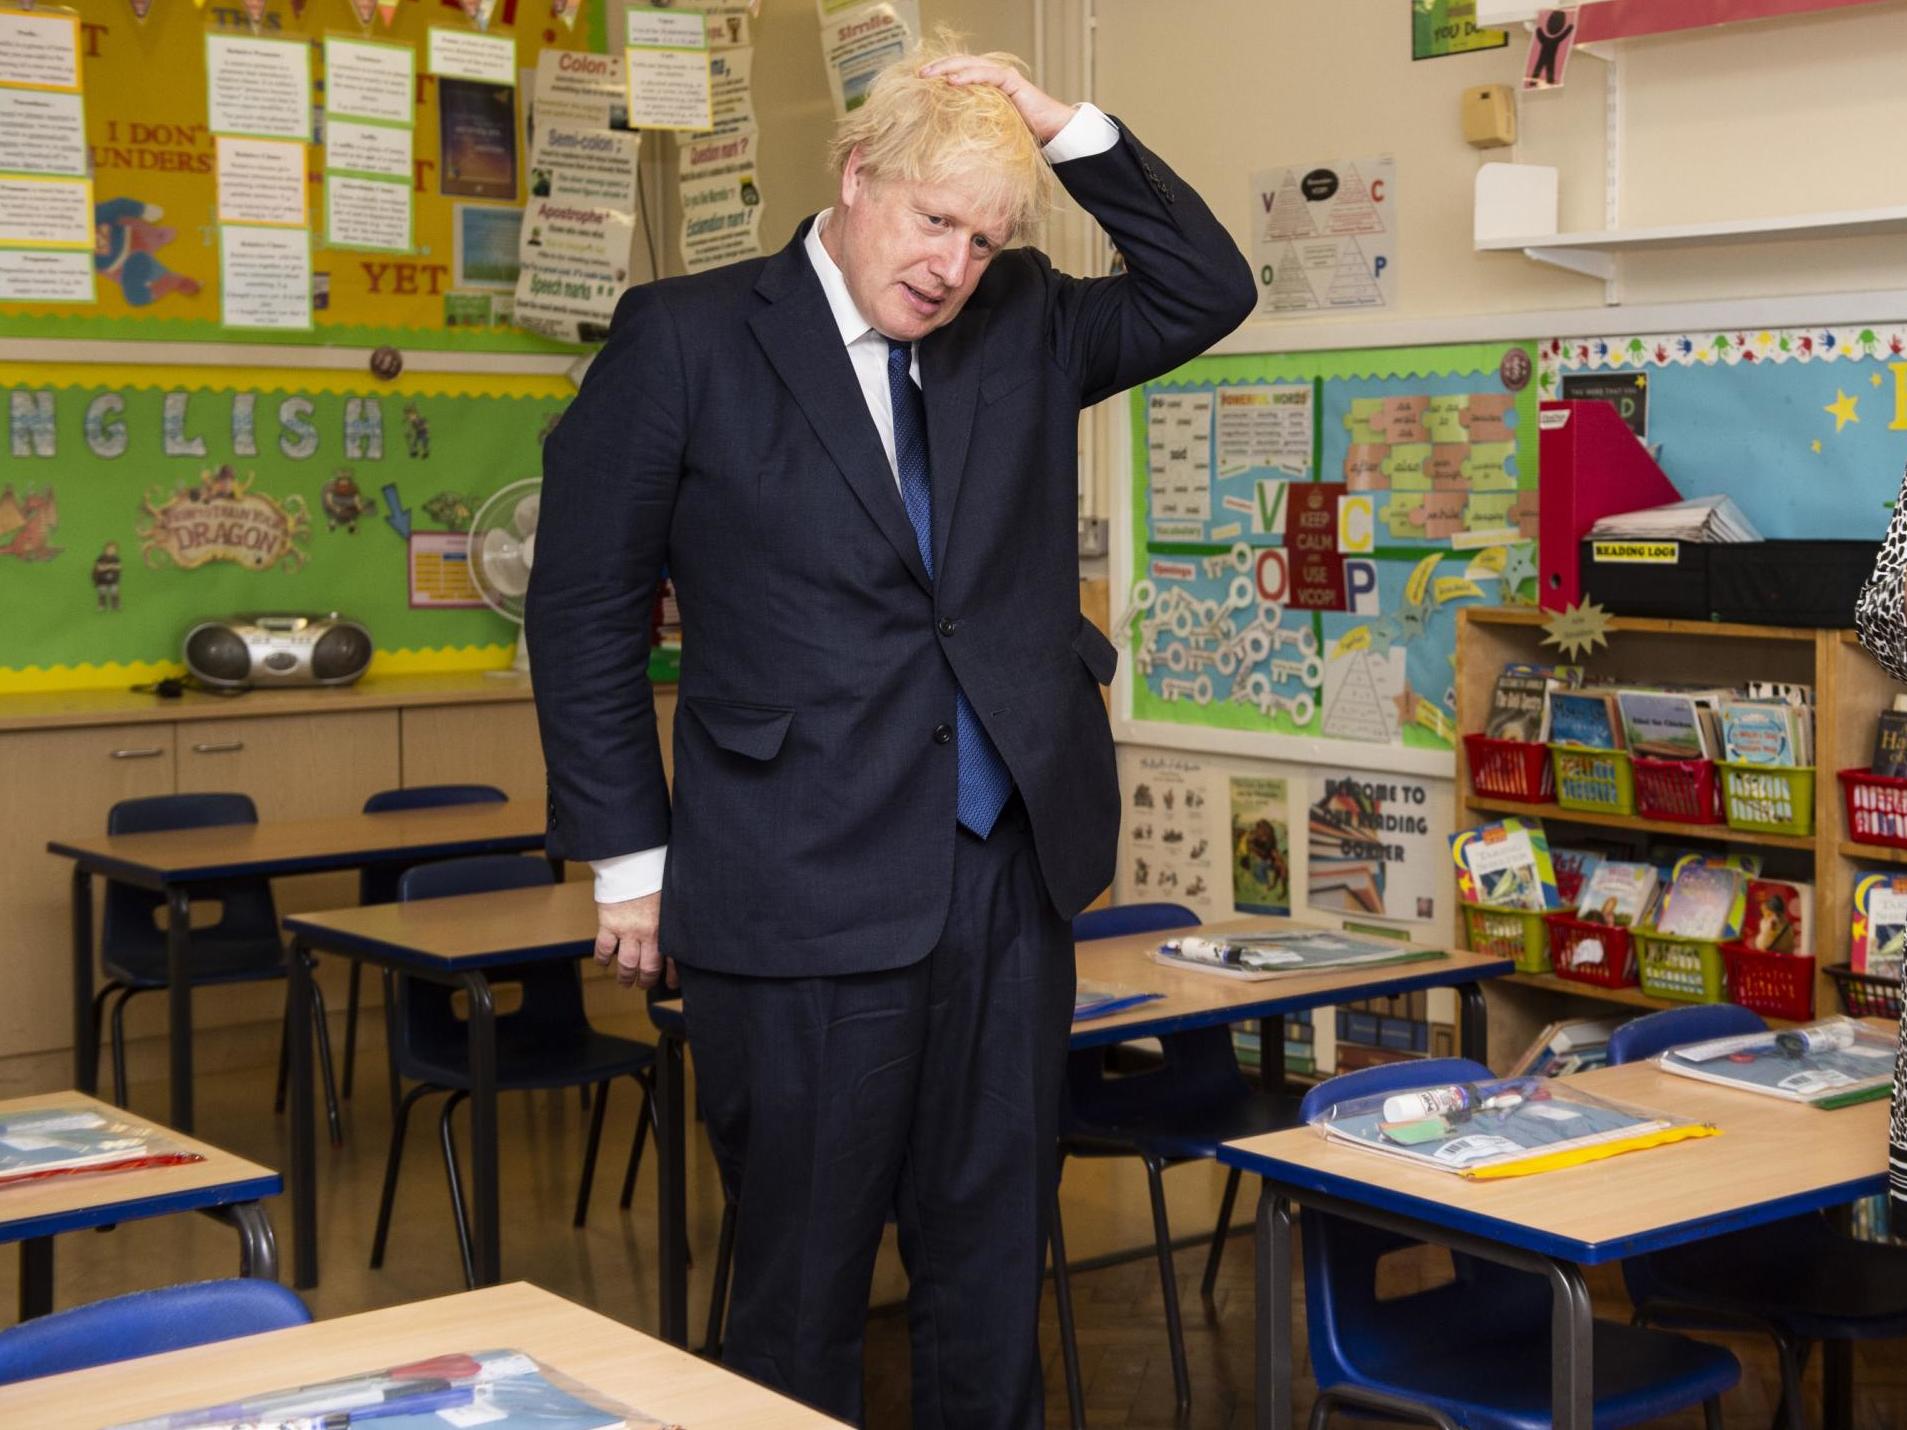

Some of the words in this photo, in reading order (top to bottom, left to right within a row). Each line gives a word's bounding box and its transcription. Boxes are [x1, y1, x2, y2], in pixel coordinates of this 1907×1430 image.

[211, 6, 282, 30] THS
[559, 52, 607, 75] Colon
[128, 121, 216, 148] DON'
[92, 145, 215, 175] UNDERS
[359, 262, 447, 296] YET
[1255, 481, 1286, 533] V
[1343, 498, 1371, 552] C
[176, 520, 278, 555] DRAGON
[1596, 545, 1646, 557] READING
[1648, 545, 1676, 557] LOGS
[1346, 561, 1376, 613] P
[1402, 785, 1426, 804] TO
